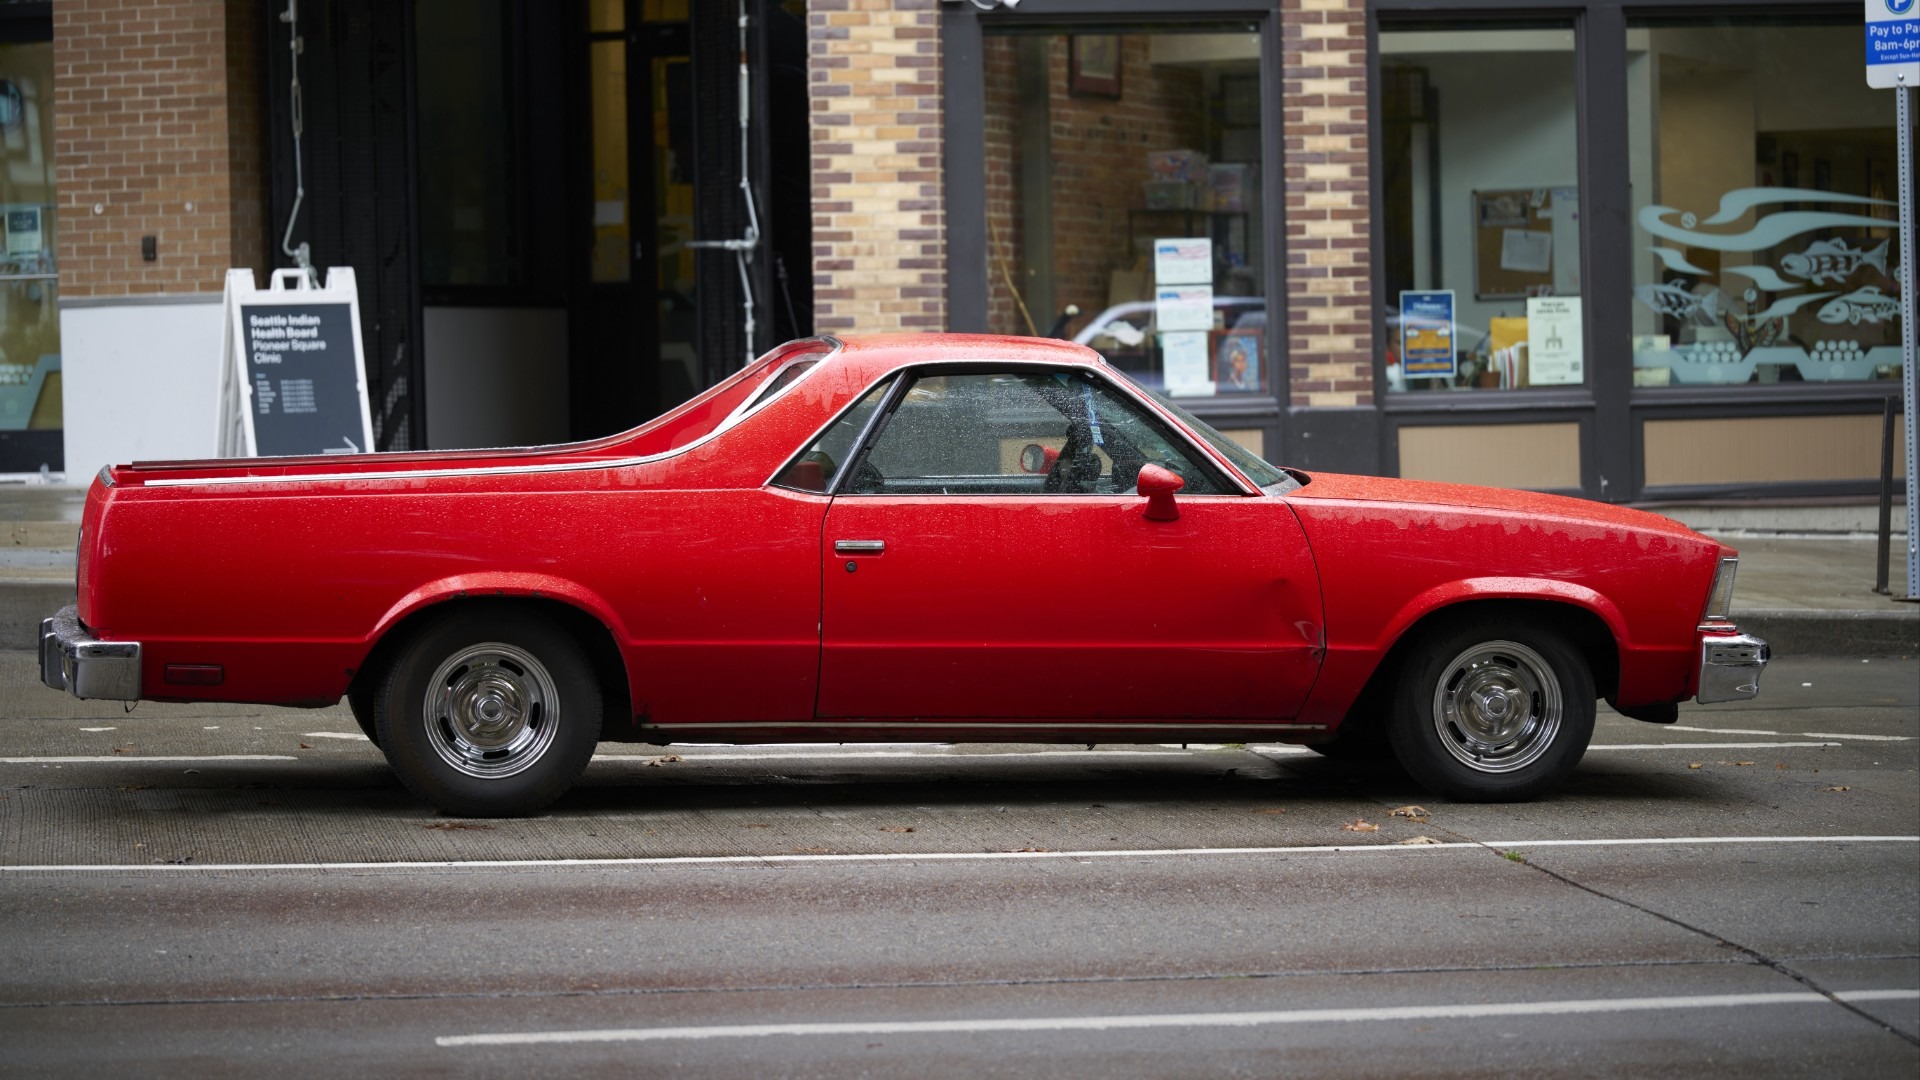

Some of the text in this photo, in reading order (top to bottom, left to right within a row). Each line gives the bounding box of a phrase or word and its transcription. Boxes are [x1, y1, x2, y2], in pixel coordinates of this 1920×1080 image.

[1870, 23, 1920, 38] Pay to Pa
[1881, 53, 1898, 61] Except
[250, 314, 321, 327] Seattle Indian
[251, 326, 318, 339] Health Board
[252, 339, 326, 352] Pioneer Square
[254, 351, 282, 364] Clinic
